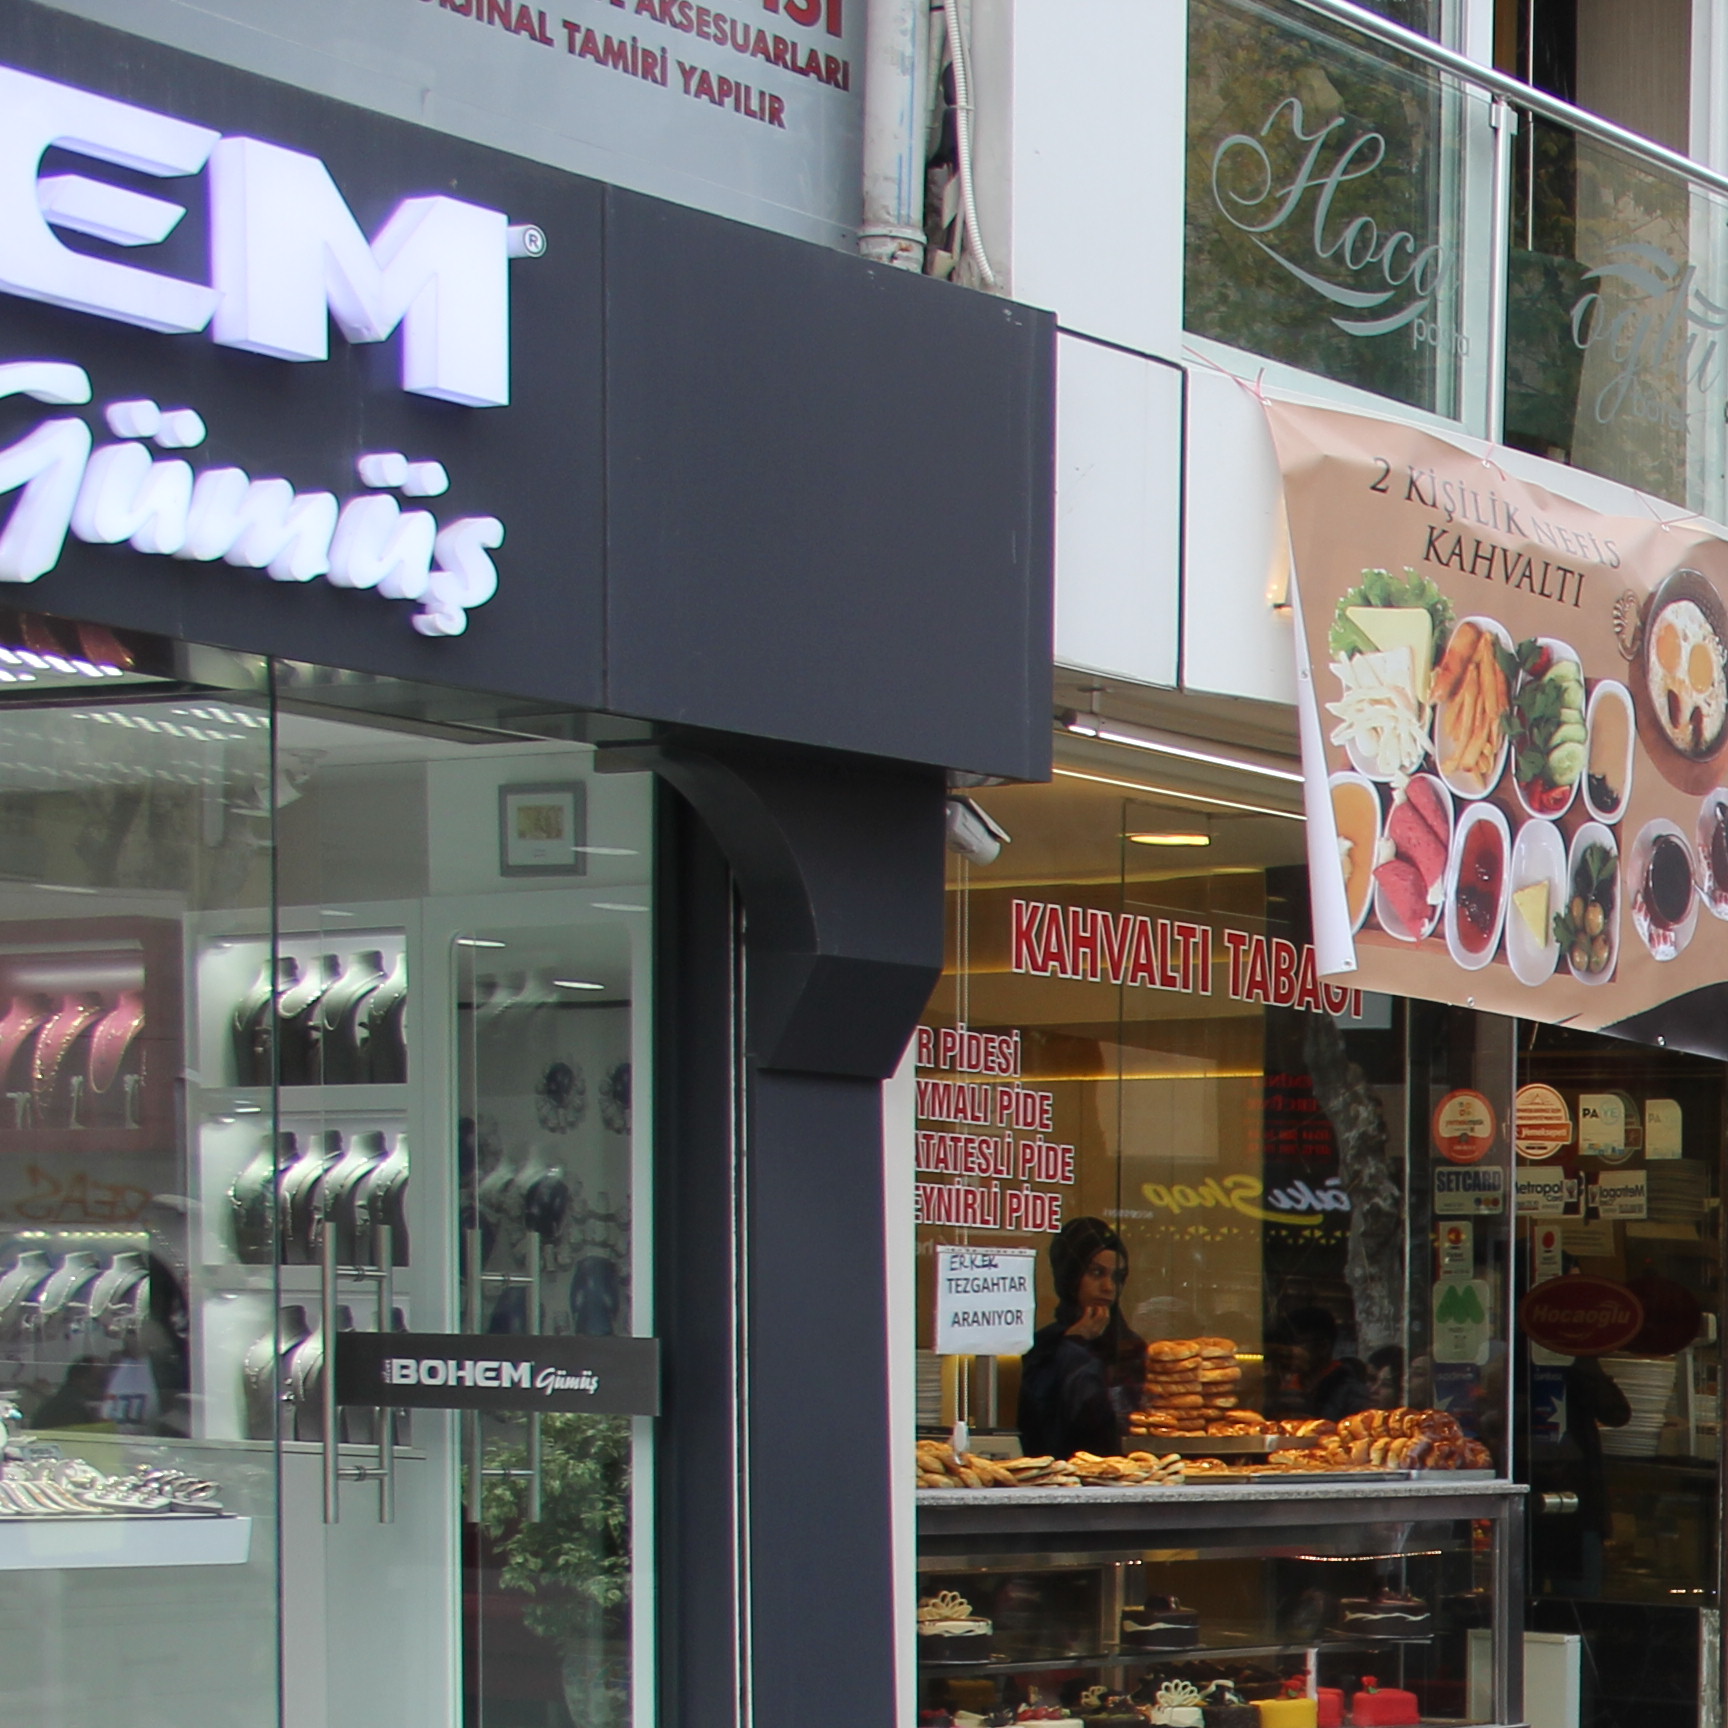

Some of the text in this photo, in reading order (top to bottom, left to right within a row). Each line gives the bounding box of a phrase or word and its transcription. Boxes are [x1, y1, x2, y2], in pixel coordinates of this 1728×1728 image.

[562, 18, 668, 88] TAMİRİ
[676, 59, 788, 130] YAPILIR
[1212, 96, 1459, 298] Hoca
[1369, 456, 1622, 570] 2 KİŞİLİK NEFİS
[1423, 524, 1586, 609] KAHVALTI
[1011, 899, 1213, 997] KAHVALTI
[940, 1022, 1022, 1077] PİDESİ
[996, 1082, 1053, 1132] PİDE
[1019, 1134, 1076, 1185] PİDE
[1436, 1169, 1502, 1193] SETCARD
[1006, 1183, 1063, 1233] PİDE
[946, 1276, 1028, 1294] TEZGAHTAR
[949, 1254, 999, 1273] ERKEK
[951, 1309, 1025, 1328] ARANIYOR
[391, 1357, 533, 1389] BOHEM
[535, 1366, 600, 1396] Gümüş
